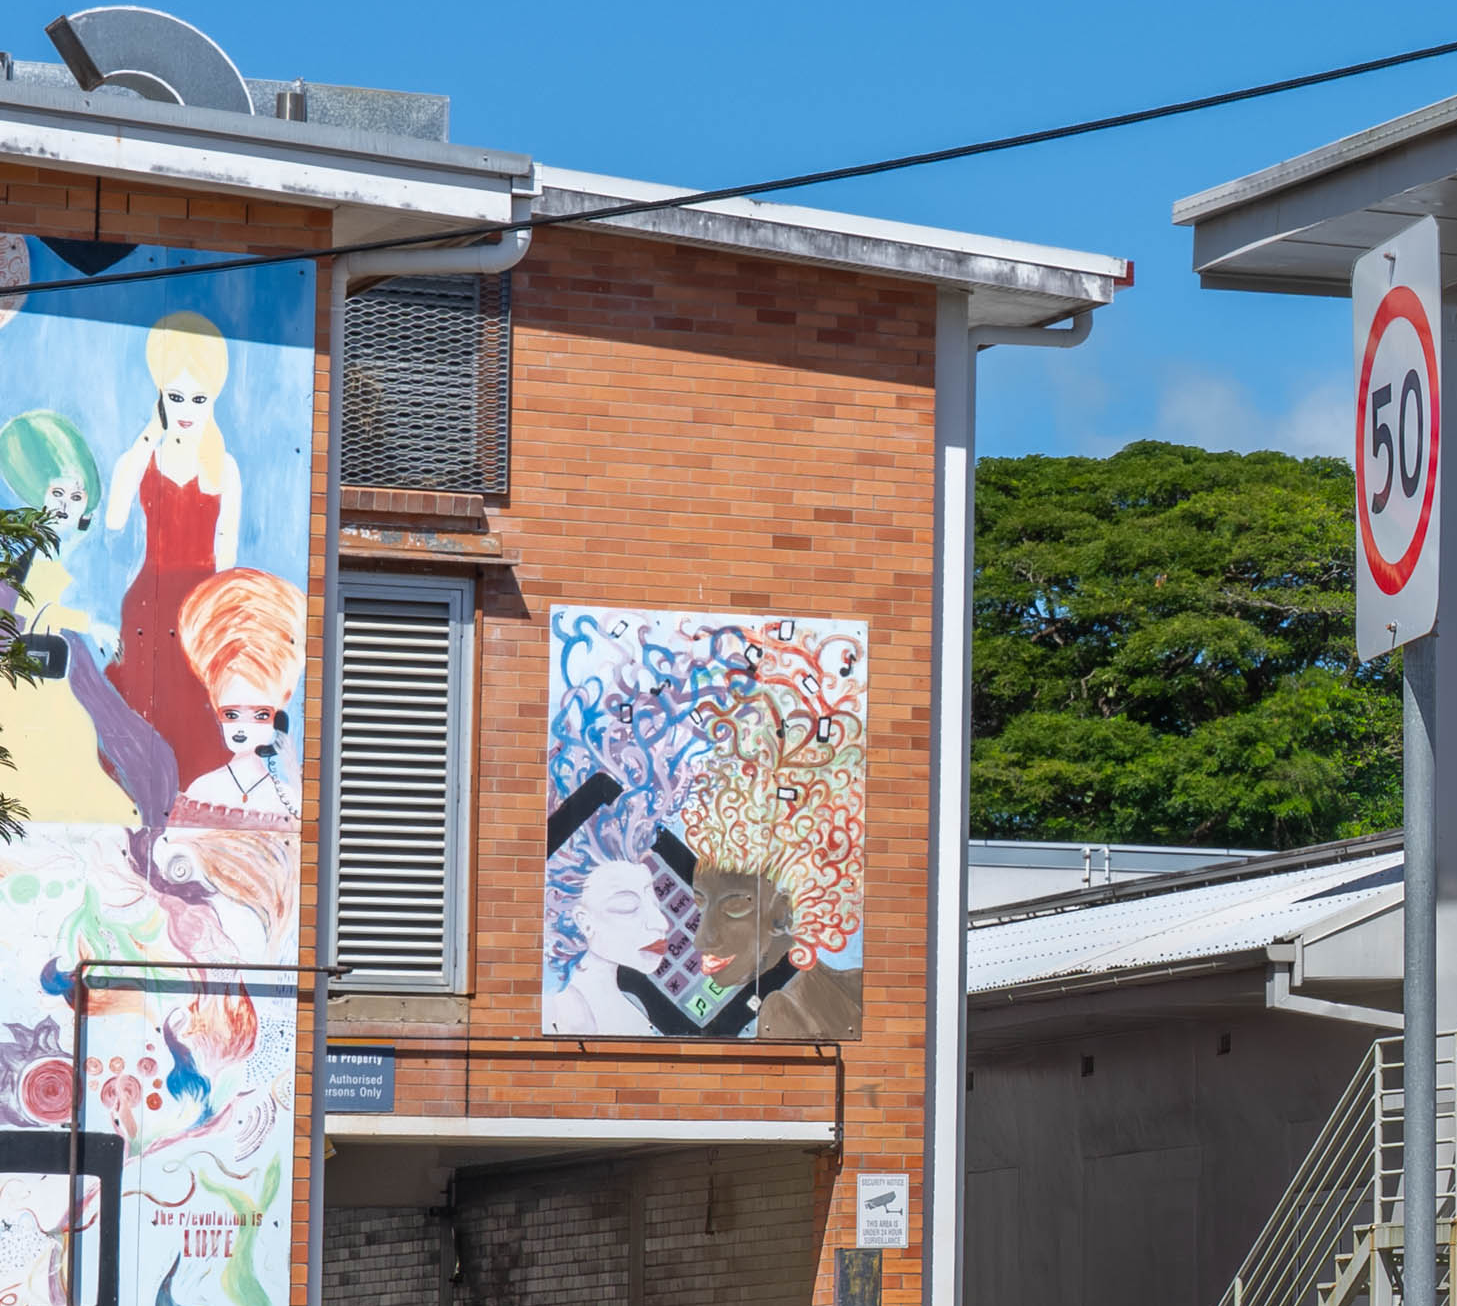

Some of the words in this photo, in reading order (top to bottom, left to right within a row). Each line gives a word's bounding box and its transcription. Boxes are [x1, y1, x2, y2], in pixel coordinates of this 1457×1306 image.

[1370, 367, 1424, 516] 50
[340, 1054, 383, 1066] Property
[329, 1074, 384, 1085] Authorised
[359, 1086, 382, 1100] Only
[183, 1229, 234, 1258] LOVE
